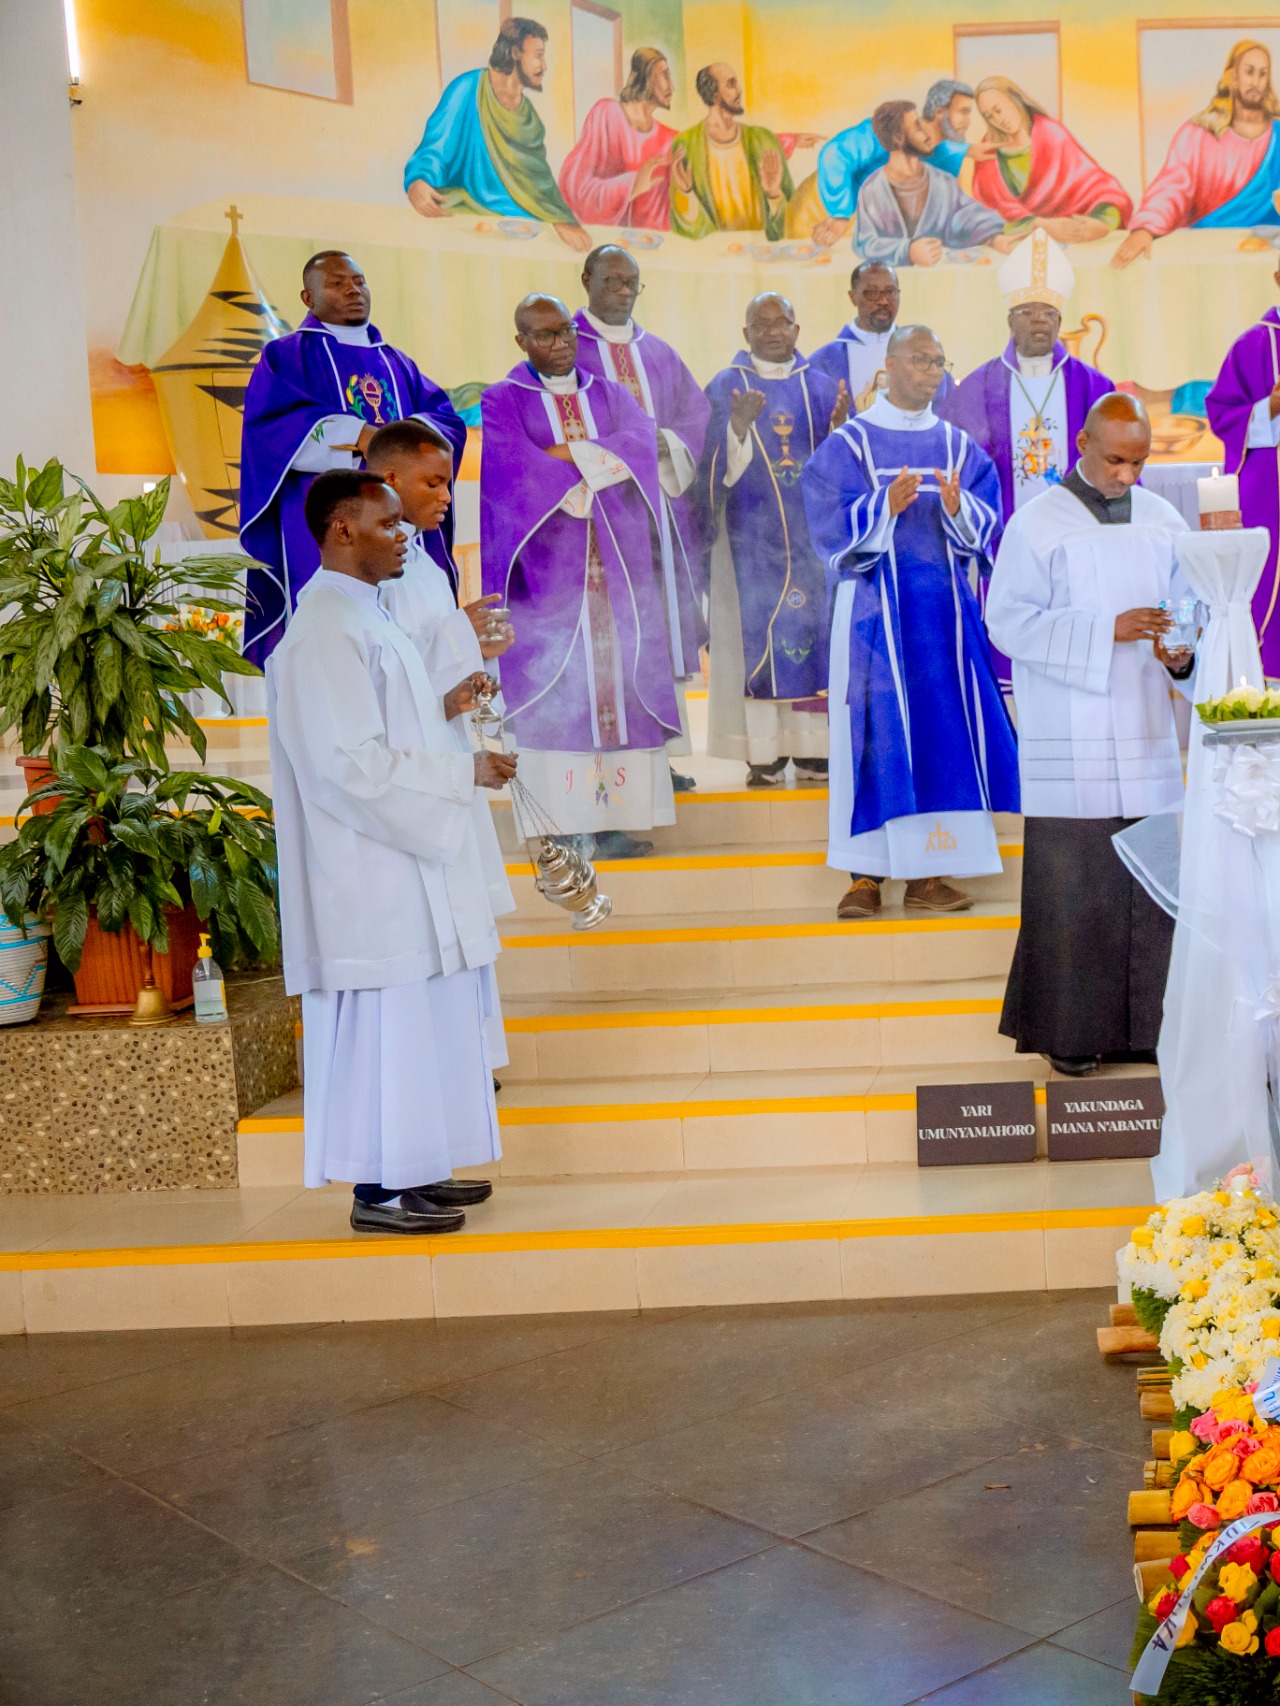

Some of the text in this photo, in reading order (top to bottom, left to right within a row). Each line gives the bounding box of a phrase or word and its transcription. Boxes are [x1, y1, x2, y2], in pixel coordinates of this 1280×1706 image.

[960, 1104, 992, 1118] YARI
[1064, 1099, 1145, 1113] YAKUNDAGA
[918, 1123, 1036, 1141] UMUNYAMAHORO
[1050, 1121, 1095, 1134] IMANA
